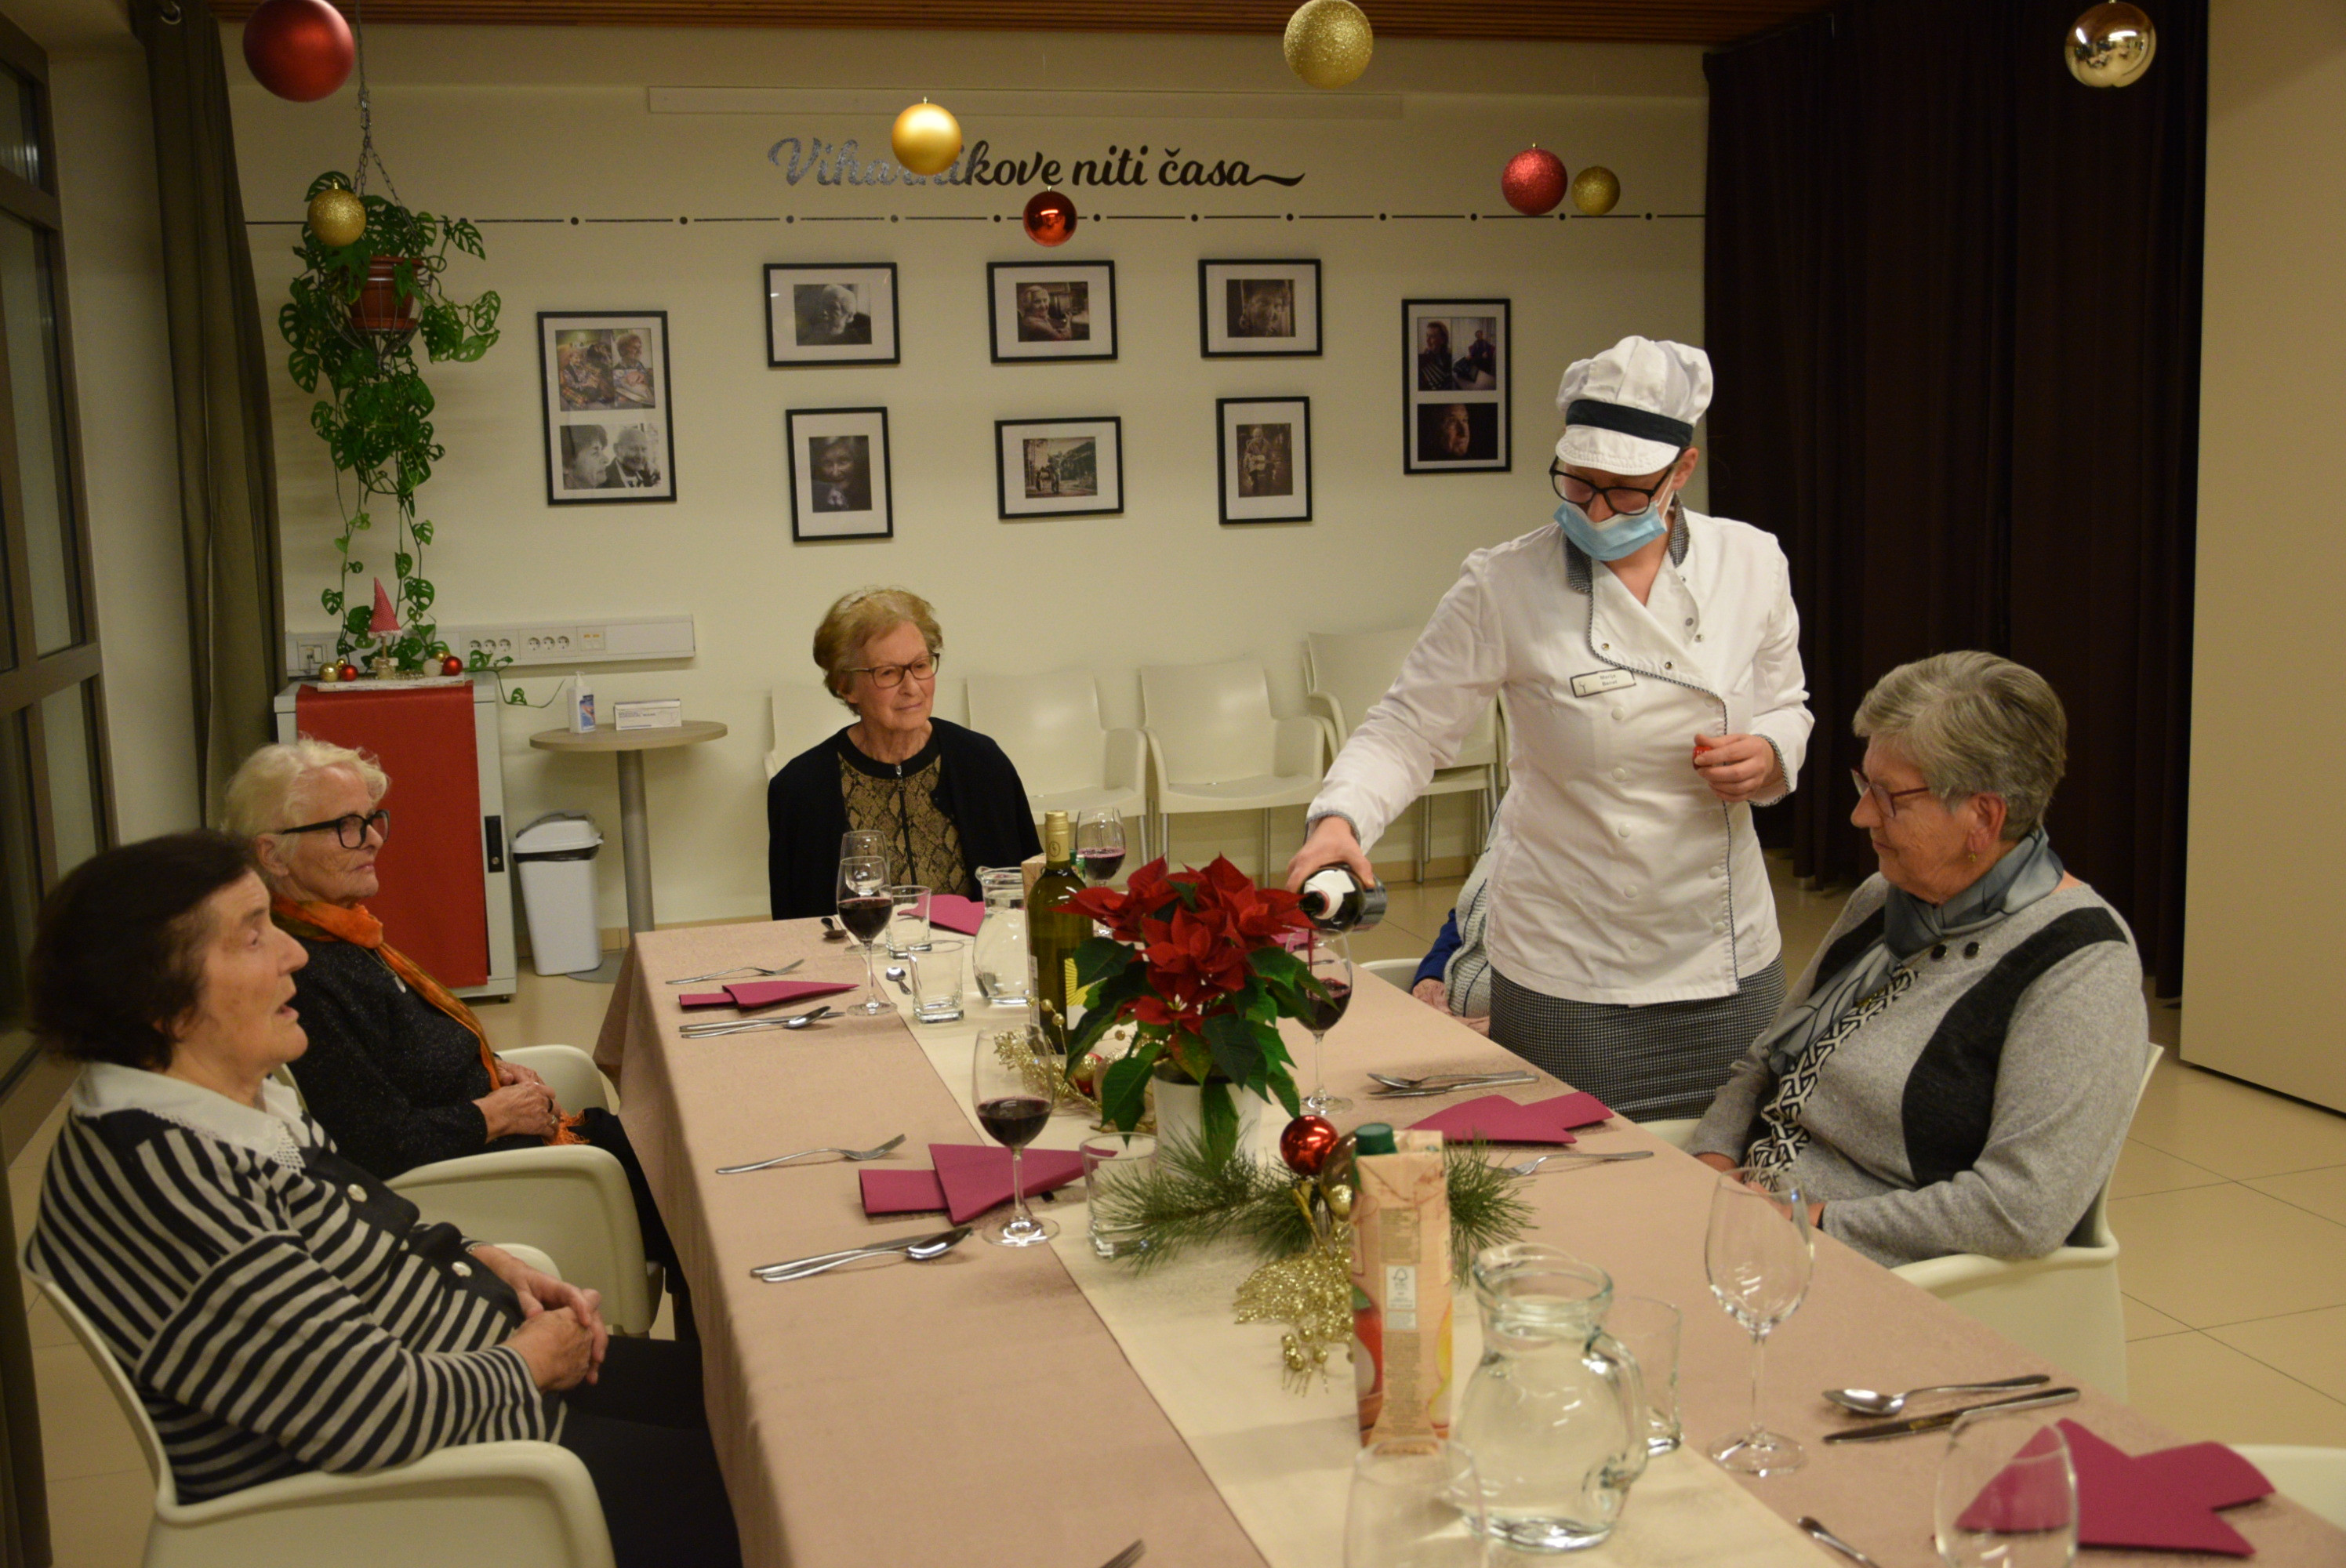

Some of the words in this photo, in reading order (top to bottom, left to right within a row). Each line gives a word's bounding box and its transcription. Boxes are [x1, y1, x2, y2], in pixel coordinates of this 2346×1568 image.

[767, 137, 1063, 187] Vihaikove
[1072, 144, 1148, 187] niti
[1158, 147, 1306, 187] časa
